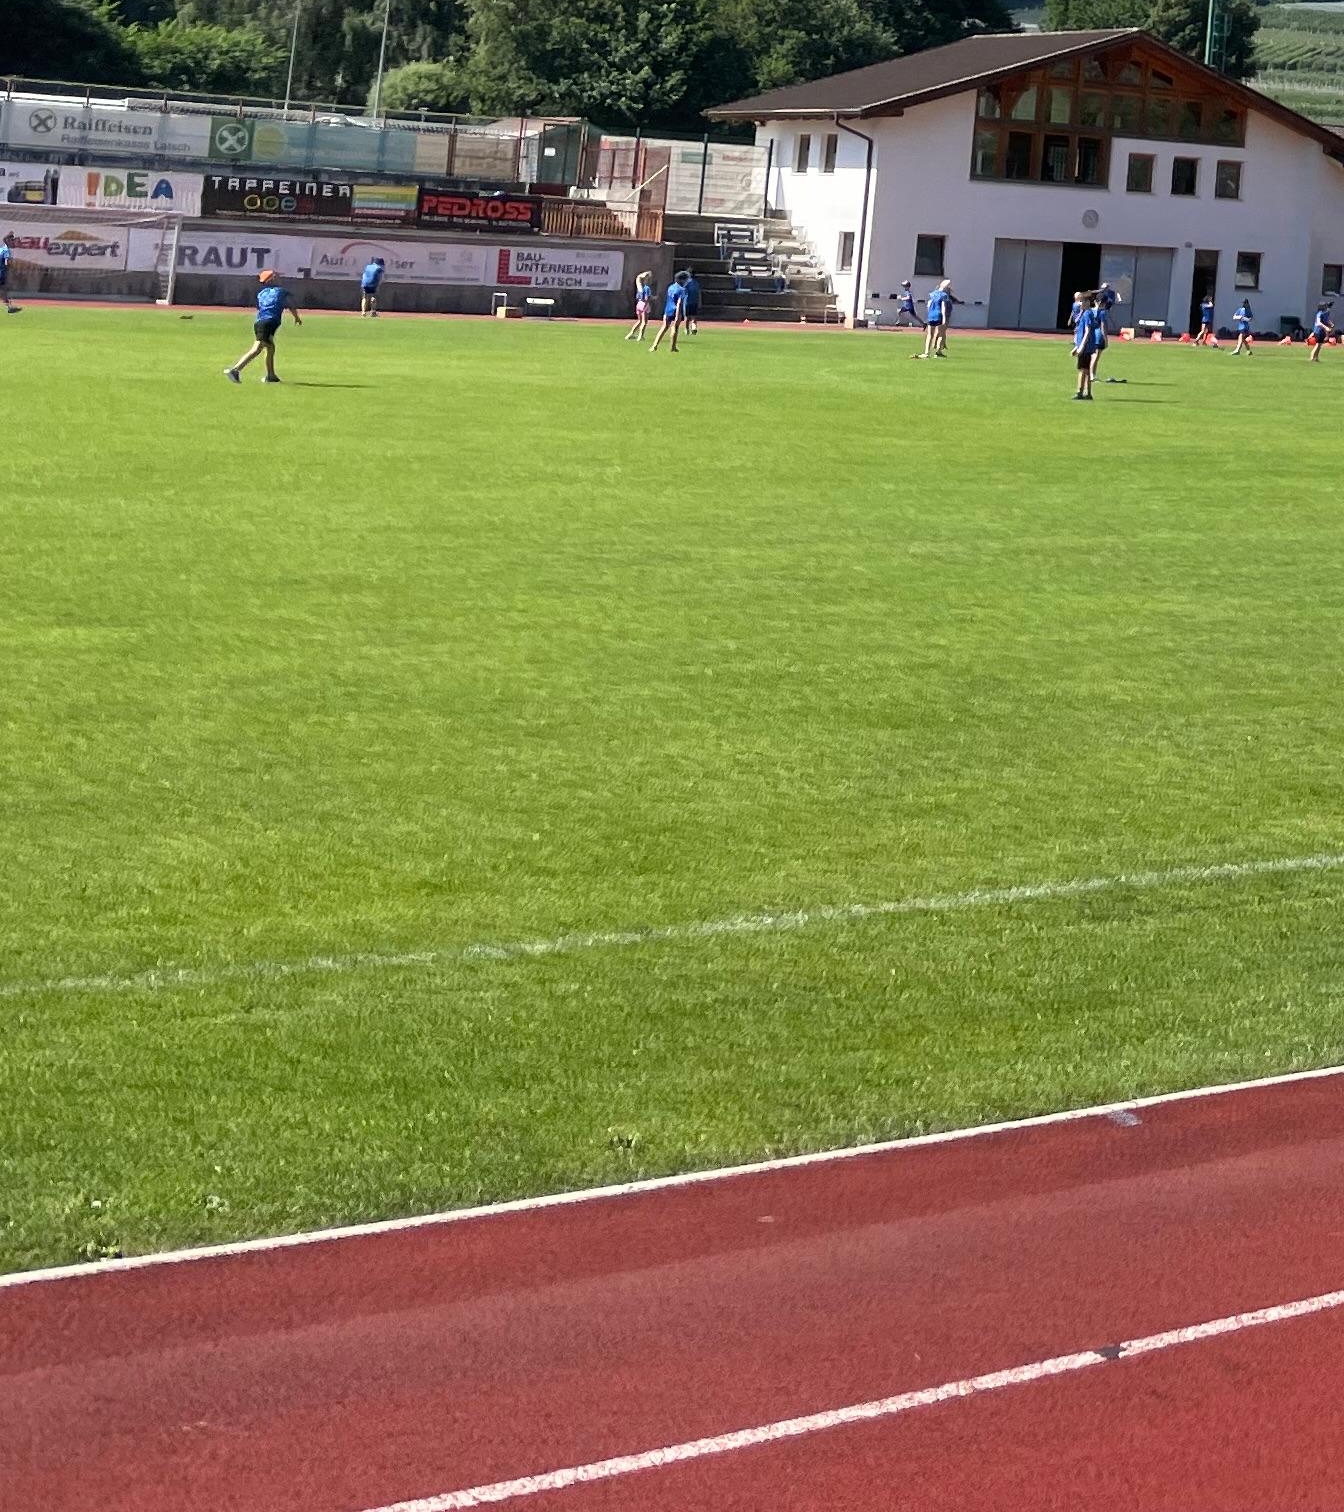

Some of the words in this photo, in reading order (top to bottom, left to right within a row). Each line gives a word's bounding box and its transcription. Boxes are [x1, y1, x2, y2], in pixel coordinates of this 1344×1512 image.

[63, 115, 153, 136] Raiffeisen
[421, 195, 532, 221] PEDROSS
[516, 251, 545, 262] BAU-
[515, 262, 610, 276] UNTERNEHMEN
[534, 276, 582, 287] LATSCH
